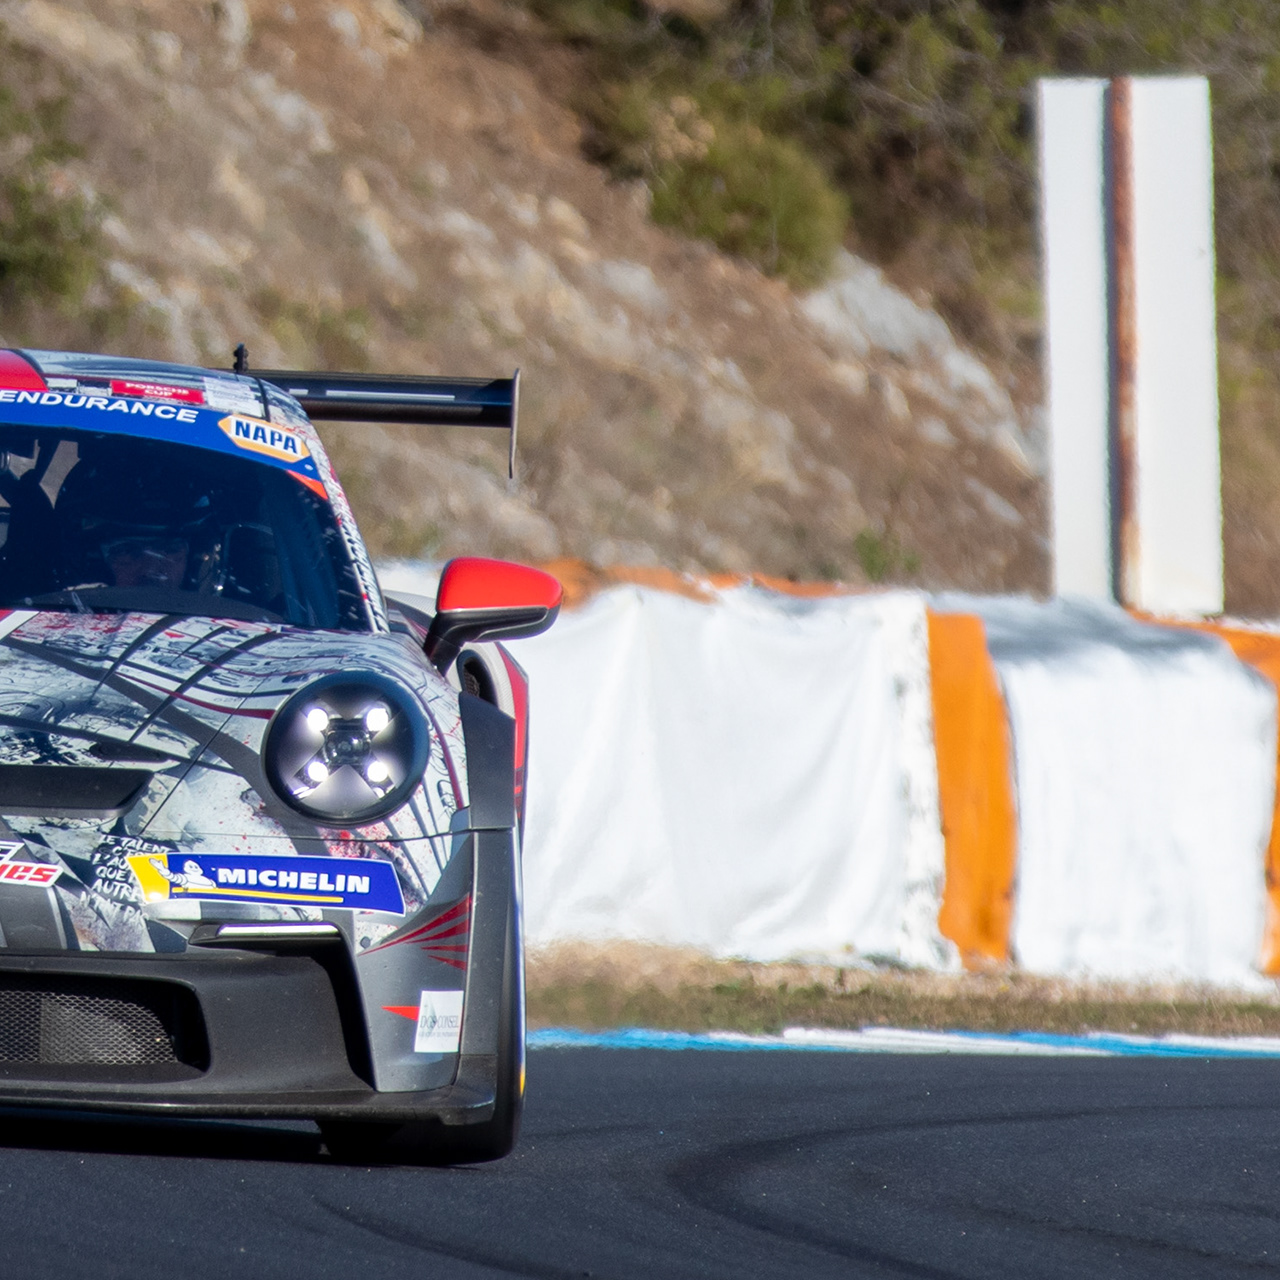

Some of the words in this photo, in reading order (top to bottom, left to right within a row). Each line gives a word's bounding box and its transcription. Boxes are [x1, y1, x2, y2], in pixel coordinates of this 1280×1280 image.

[144, 389, 173, 397] CUP
[234, 419, 298, 454] NAPA
[121, 836, 170, 855] TALENT
[95, 865, 127, 881] QUE
[218, 868, 370, 894] MICHELIN
